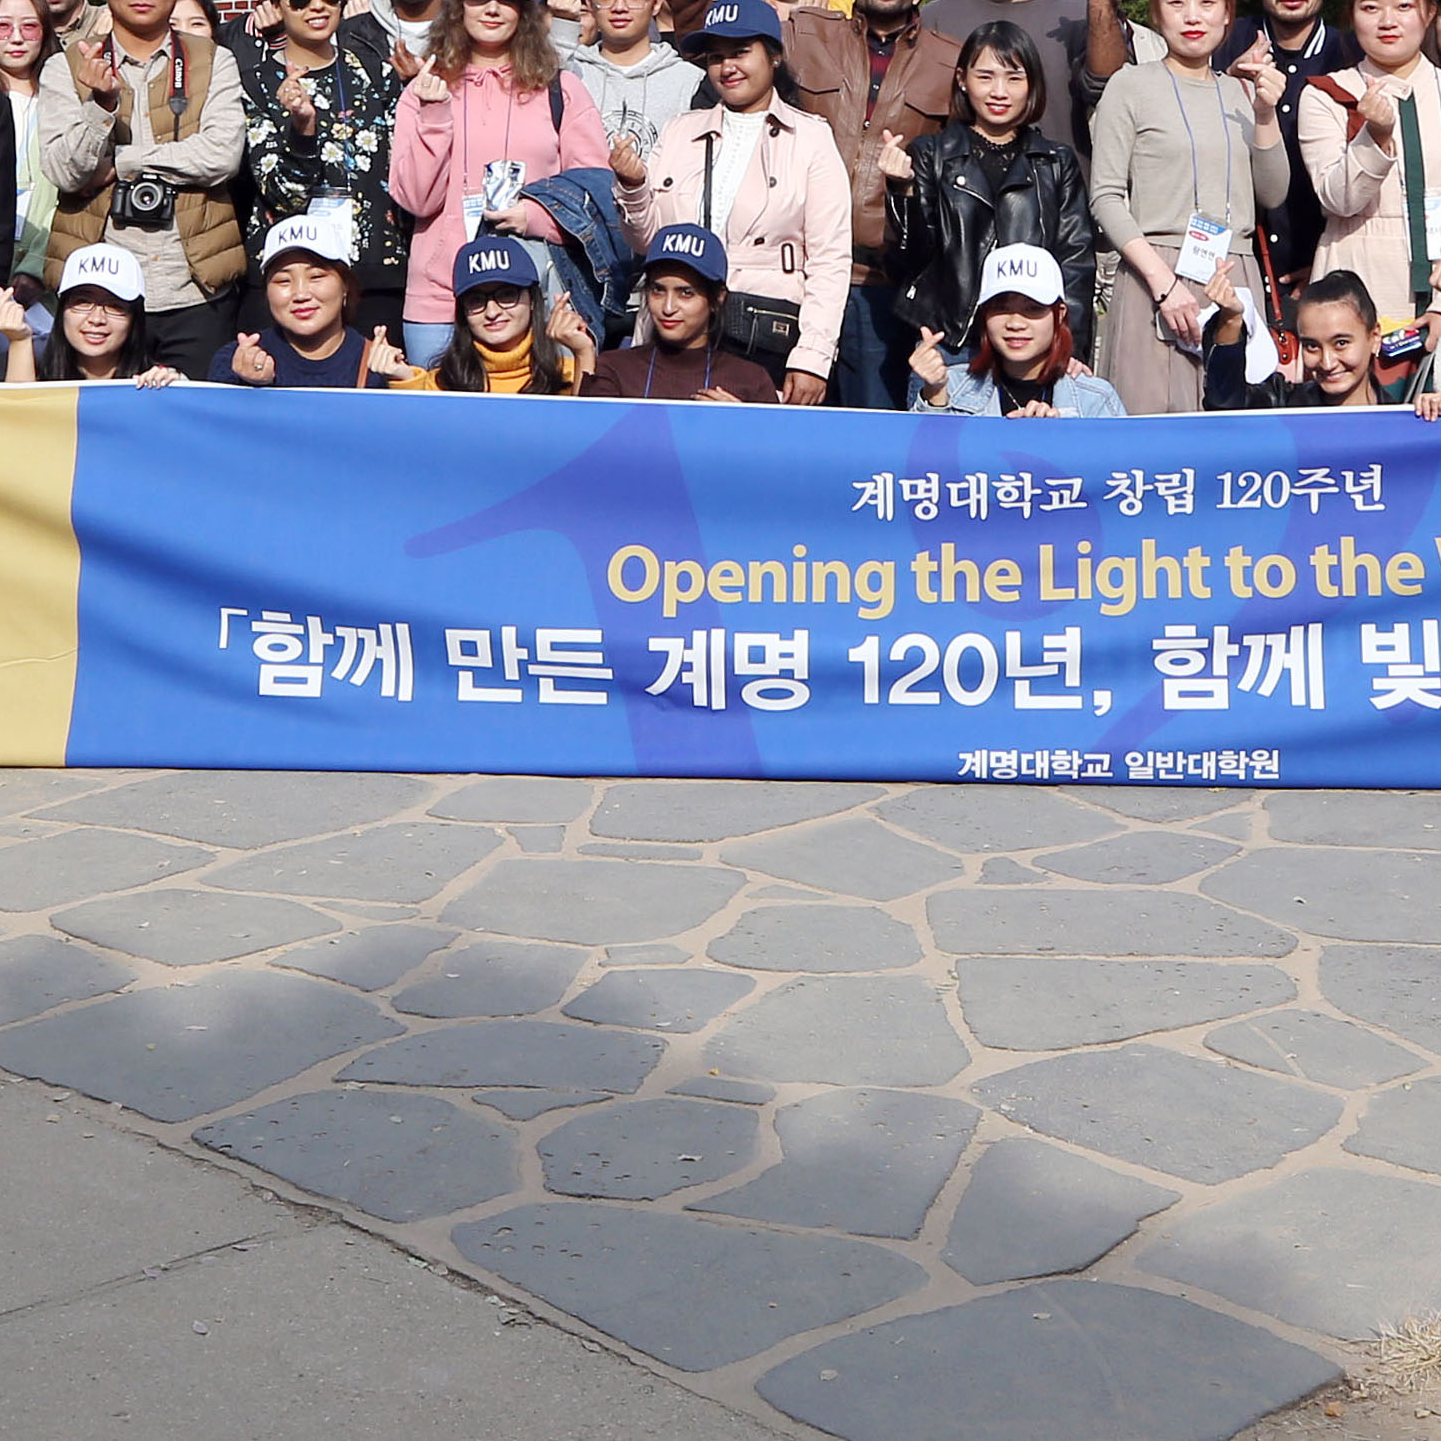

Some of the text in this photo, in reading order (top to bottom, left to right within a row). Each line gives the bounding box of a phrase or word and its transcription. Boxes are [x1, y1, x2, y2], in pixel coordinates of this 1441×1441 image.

[705, 5, 738, 29] KMU
[278, 226, 317, 243] KMU
[662, 234, 704, 257] KMU
[79, 257, 119, 274] KMU
[469, 250, 510, 273] KMU
[997, 259, 1037, 277] KMU
[851, 463, 1387, 521] 계명대학교 창립 120주년
[607, 543, 896, 620] Opening
[911, 542, 1023, 604] the
[1039, 538, 1211, 617] Light
[1224, 544, 1296, 599] to
[1310, 535, 1425, 597] the
[218, 606, 415, 703] 「함께
[445, 624, 614, 706] 만든
[645, 627, 811, 712] 계명
[847, 625, 1113, 718] 120년,
[1151, 621, 1326, 711] 함께
[957, 748, 1281, 781] 계명대학교 일반대학원
